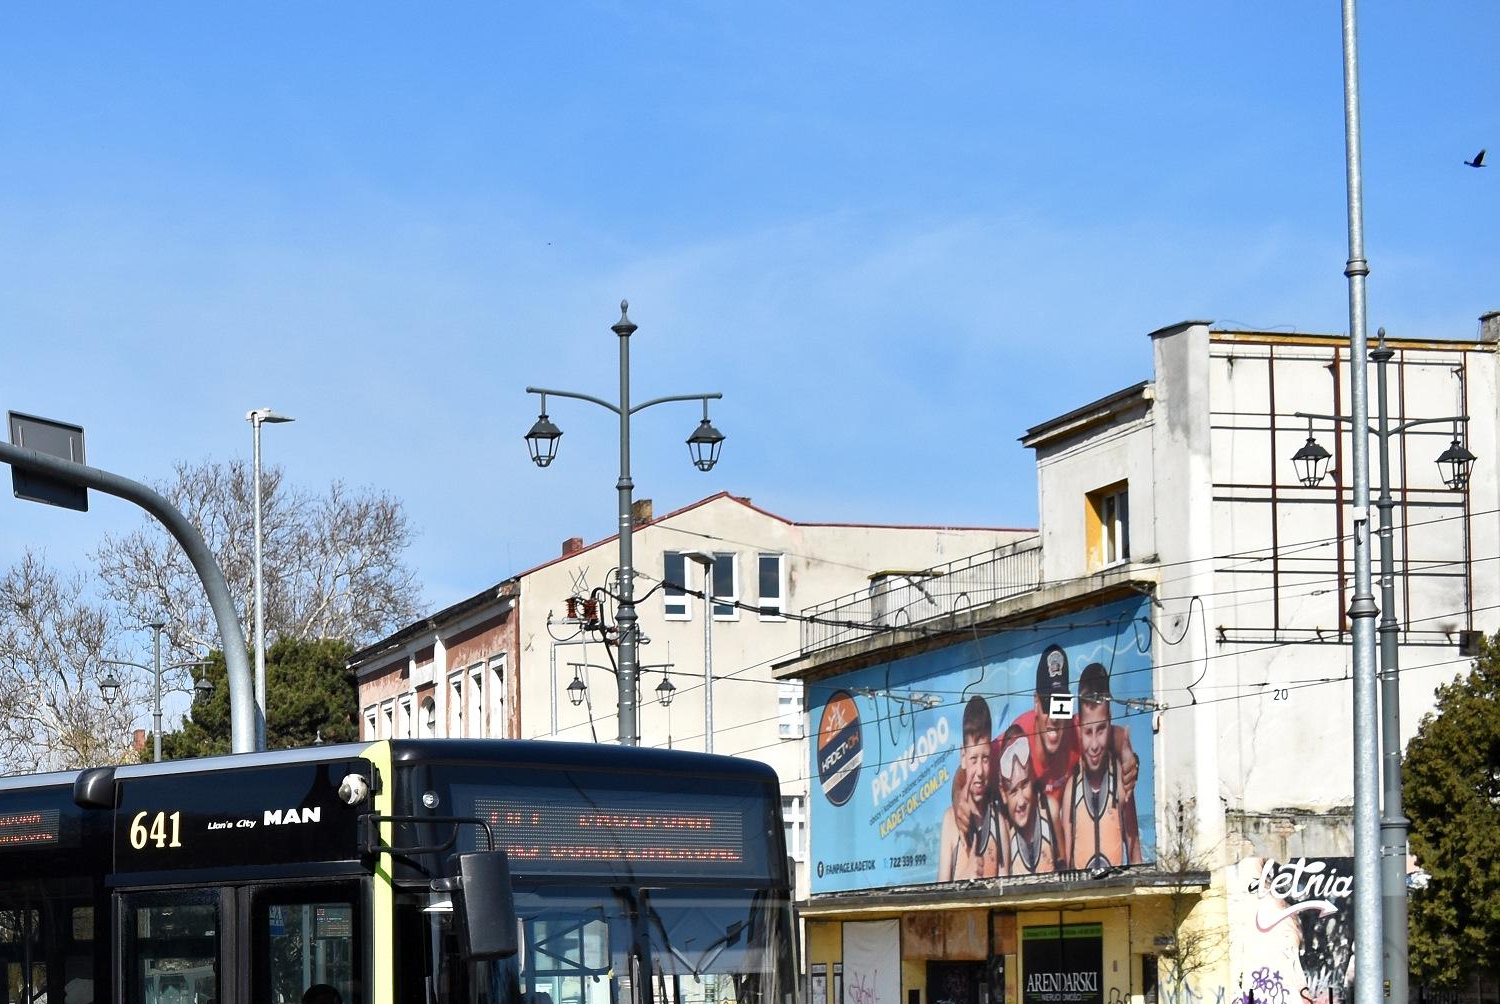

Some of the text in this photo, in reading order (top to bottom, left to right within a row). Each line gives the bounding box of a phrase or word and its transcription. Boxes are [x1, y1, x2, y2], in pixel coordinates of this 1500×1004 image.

[1273, 688, 1289, 701] 20
[129, 810, 182, 850] 641
[207, 806, 321, 830] Lion's City MAN
[1250, 857, 1354, 900] letnia
[1026, 971, 1098, 992] ARENDARSKI
